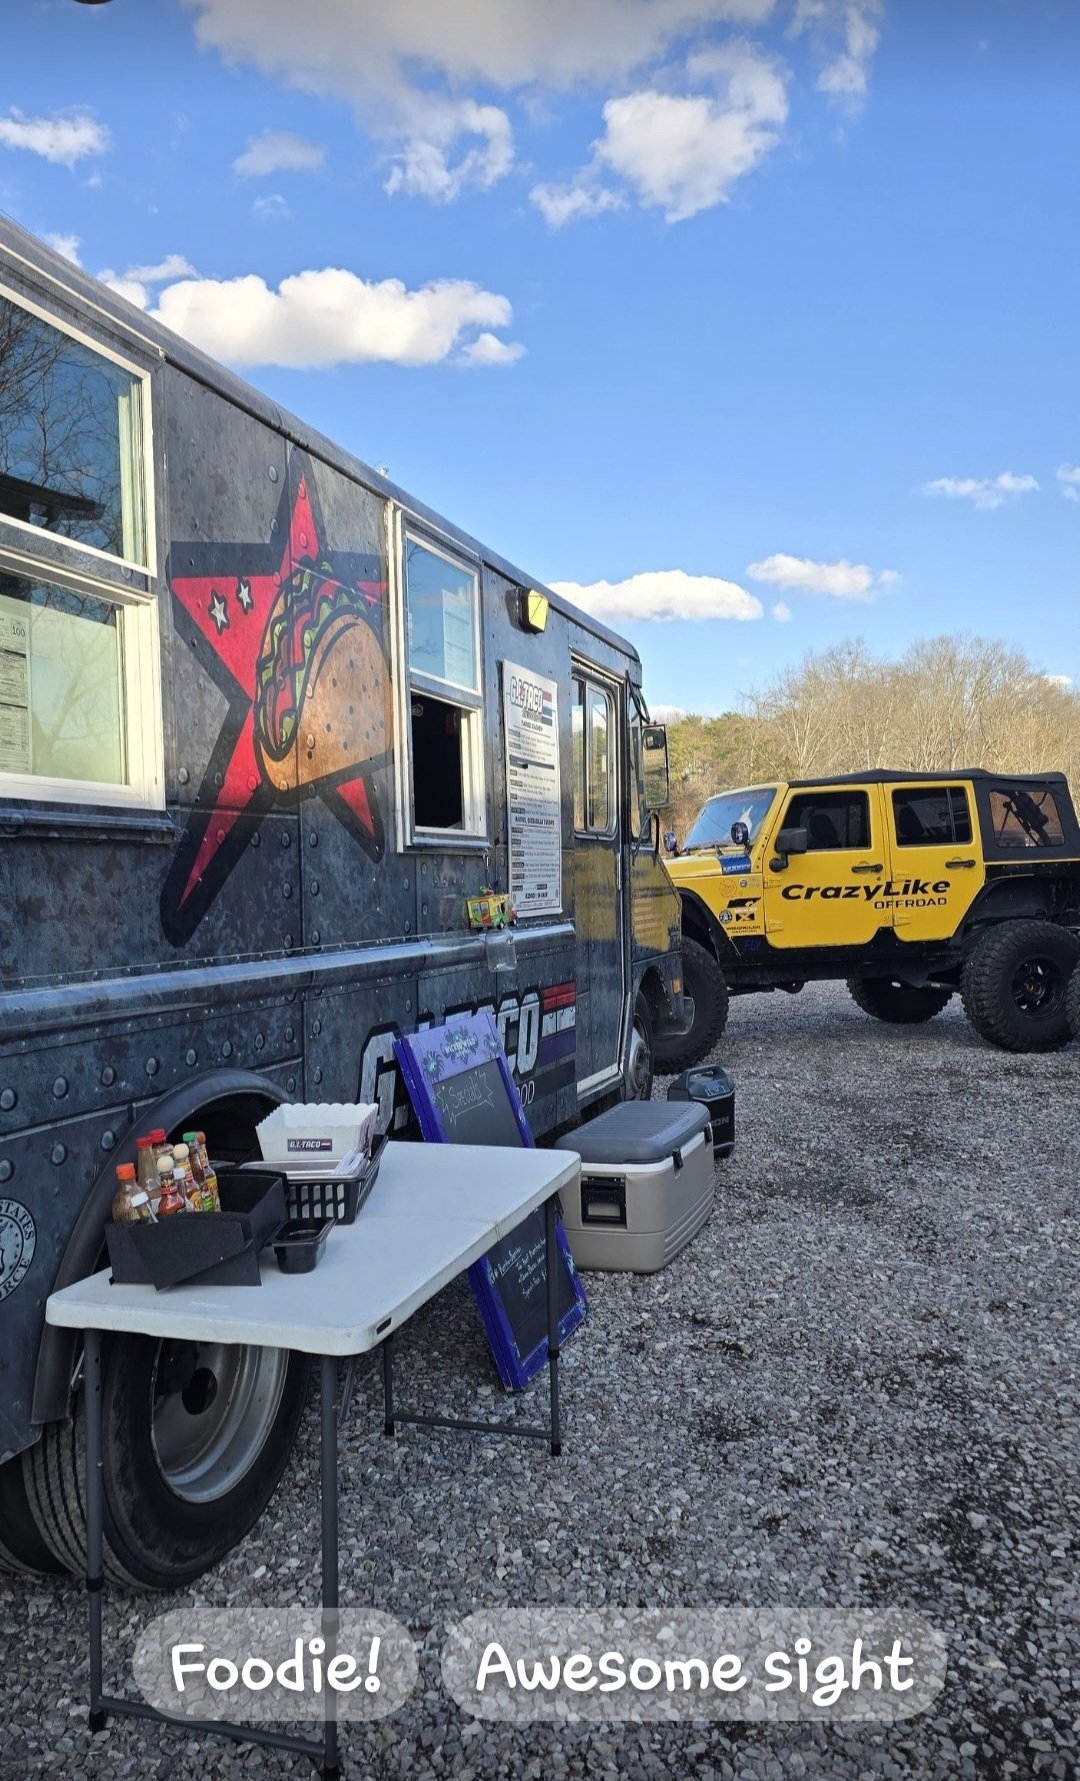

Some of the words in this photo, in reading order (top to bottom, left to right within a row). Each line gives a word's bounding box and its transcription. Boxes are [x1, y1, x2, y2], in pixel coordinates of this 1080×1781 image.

[12, 625, 26, 638] 100
[781, 879, 951, 901] CrazyLike
[874, 898, 947, 910] OFFROAD
